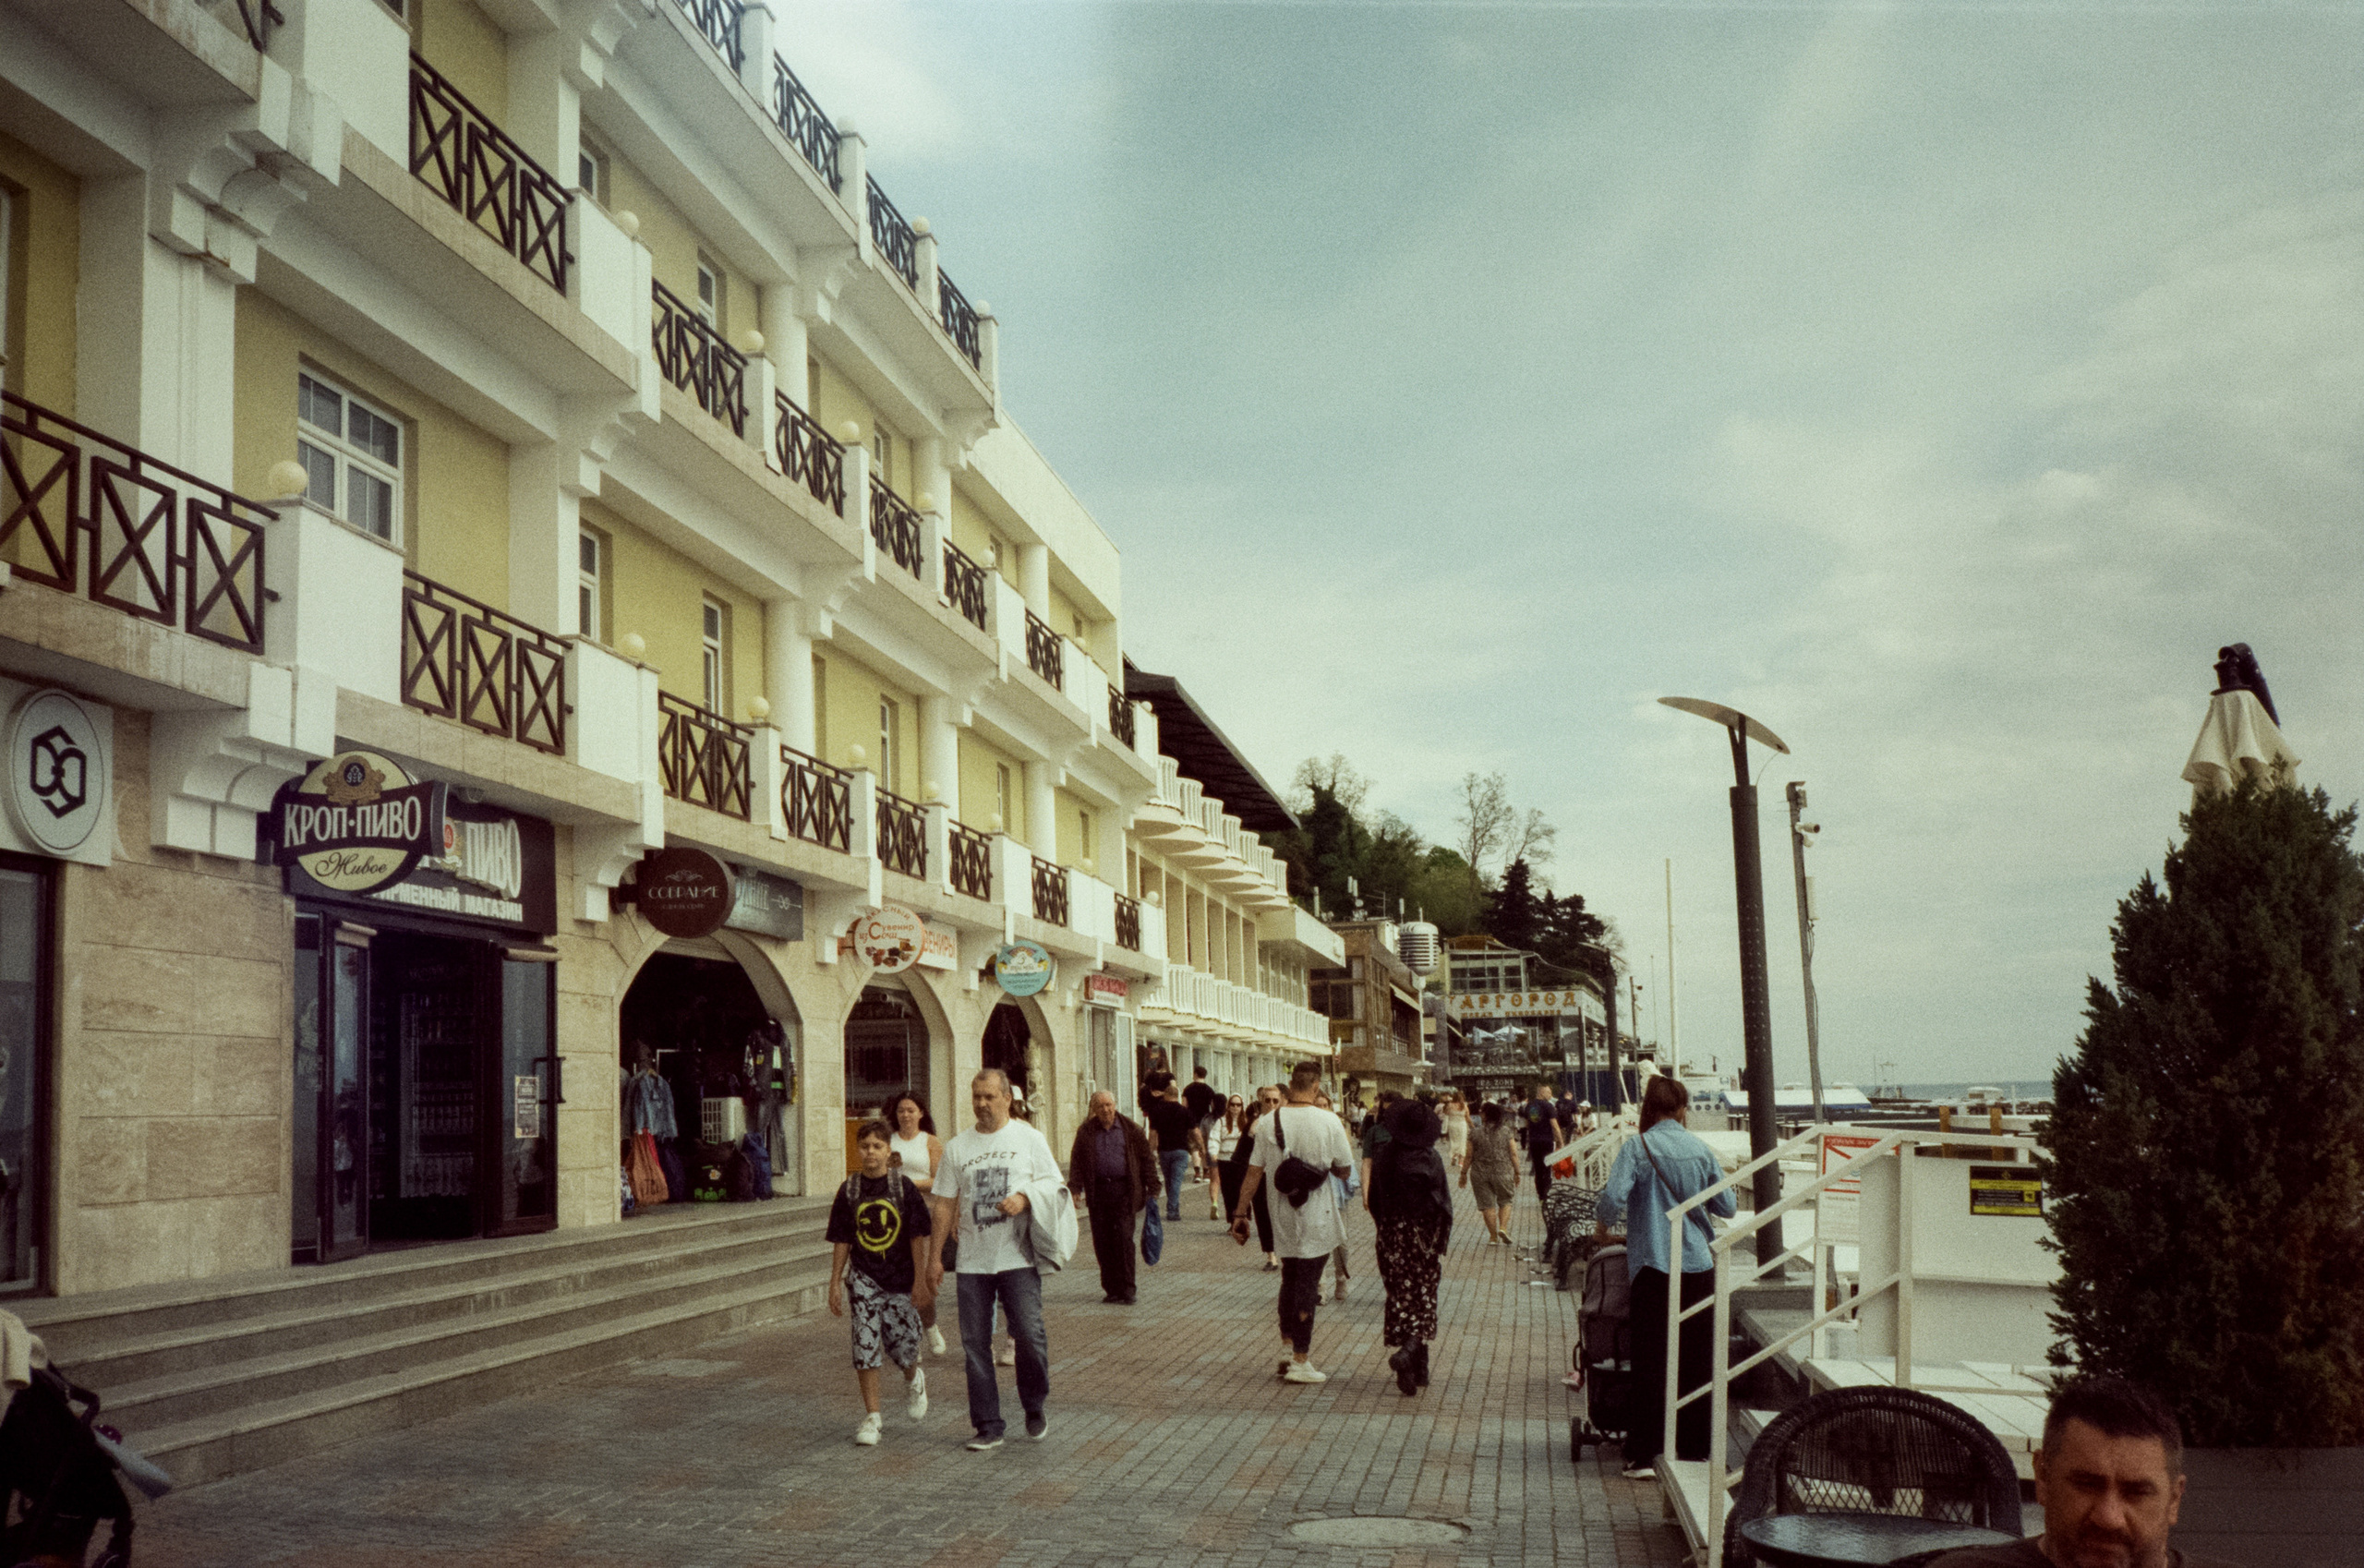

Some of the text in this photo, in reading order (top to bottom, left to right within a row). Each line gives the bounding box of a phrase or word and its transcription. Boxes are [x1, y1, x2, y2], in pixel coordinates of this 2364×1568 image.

[314, 851, 388, 880] Живое
[465, 818, 522, 899] ПИВО
[364, 882, 523, 922] ИРМЕННЫЙ МАГАЗИН
[962, 1151, 1018, 1172] PROJECT
